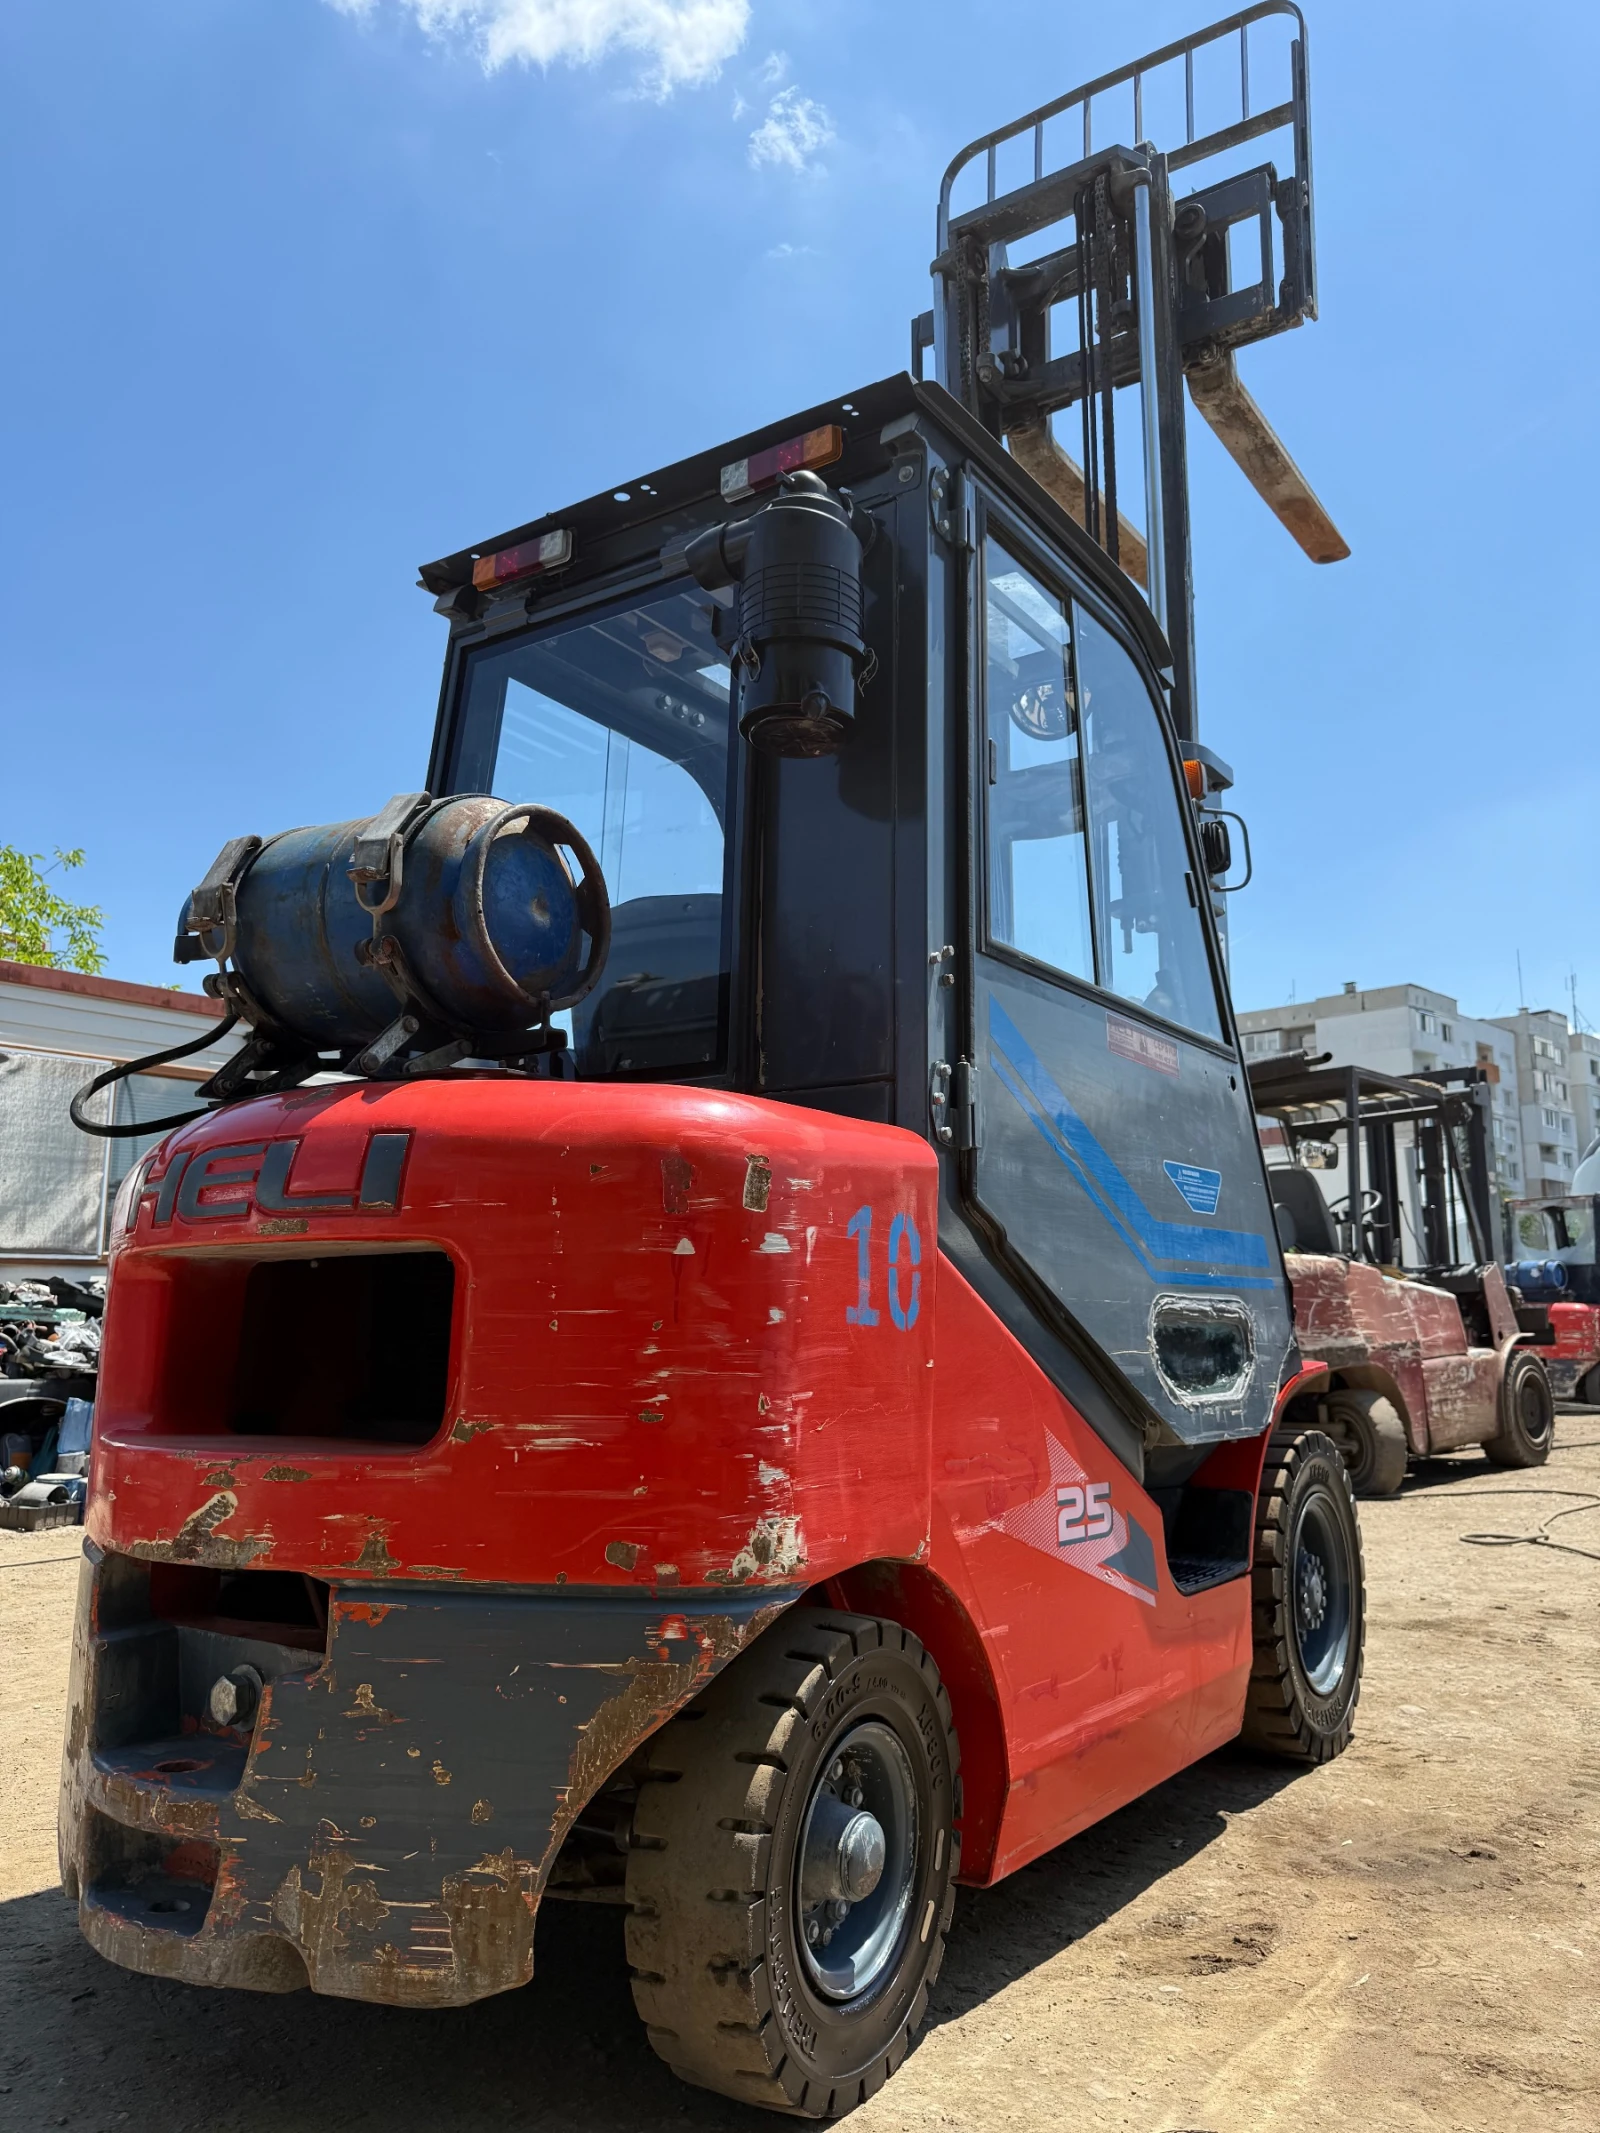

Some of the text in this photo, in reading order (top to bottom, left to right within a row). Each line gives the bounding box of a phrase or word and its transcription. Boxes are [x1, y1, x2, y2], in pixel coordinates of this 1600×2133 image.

[126, 1133, 411, 1230] HELI
[845, 1204, 922, 1333] 10
[1056, 1481, 1114, 1548] 25
[916, 1702, 944, 1791] XP800
[769, 1885, 819, 2063] TRELLEBORG
